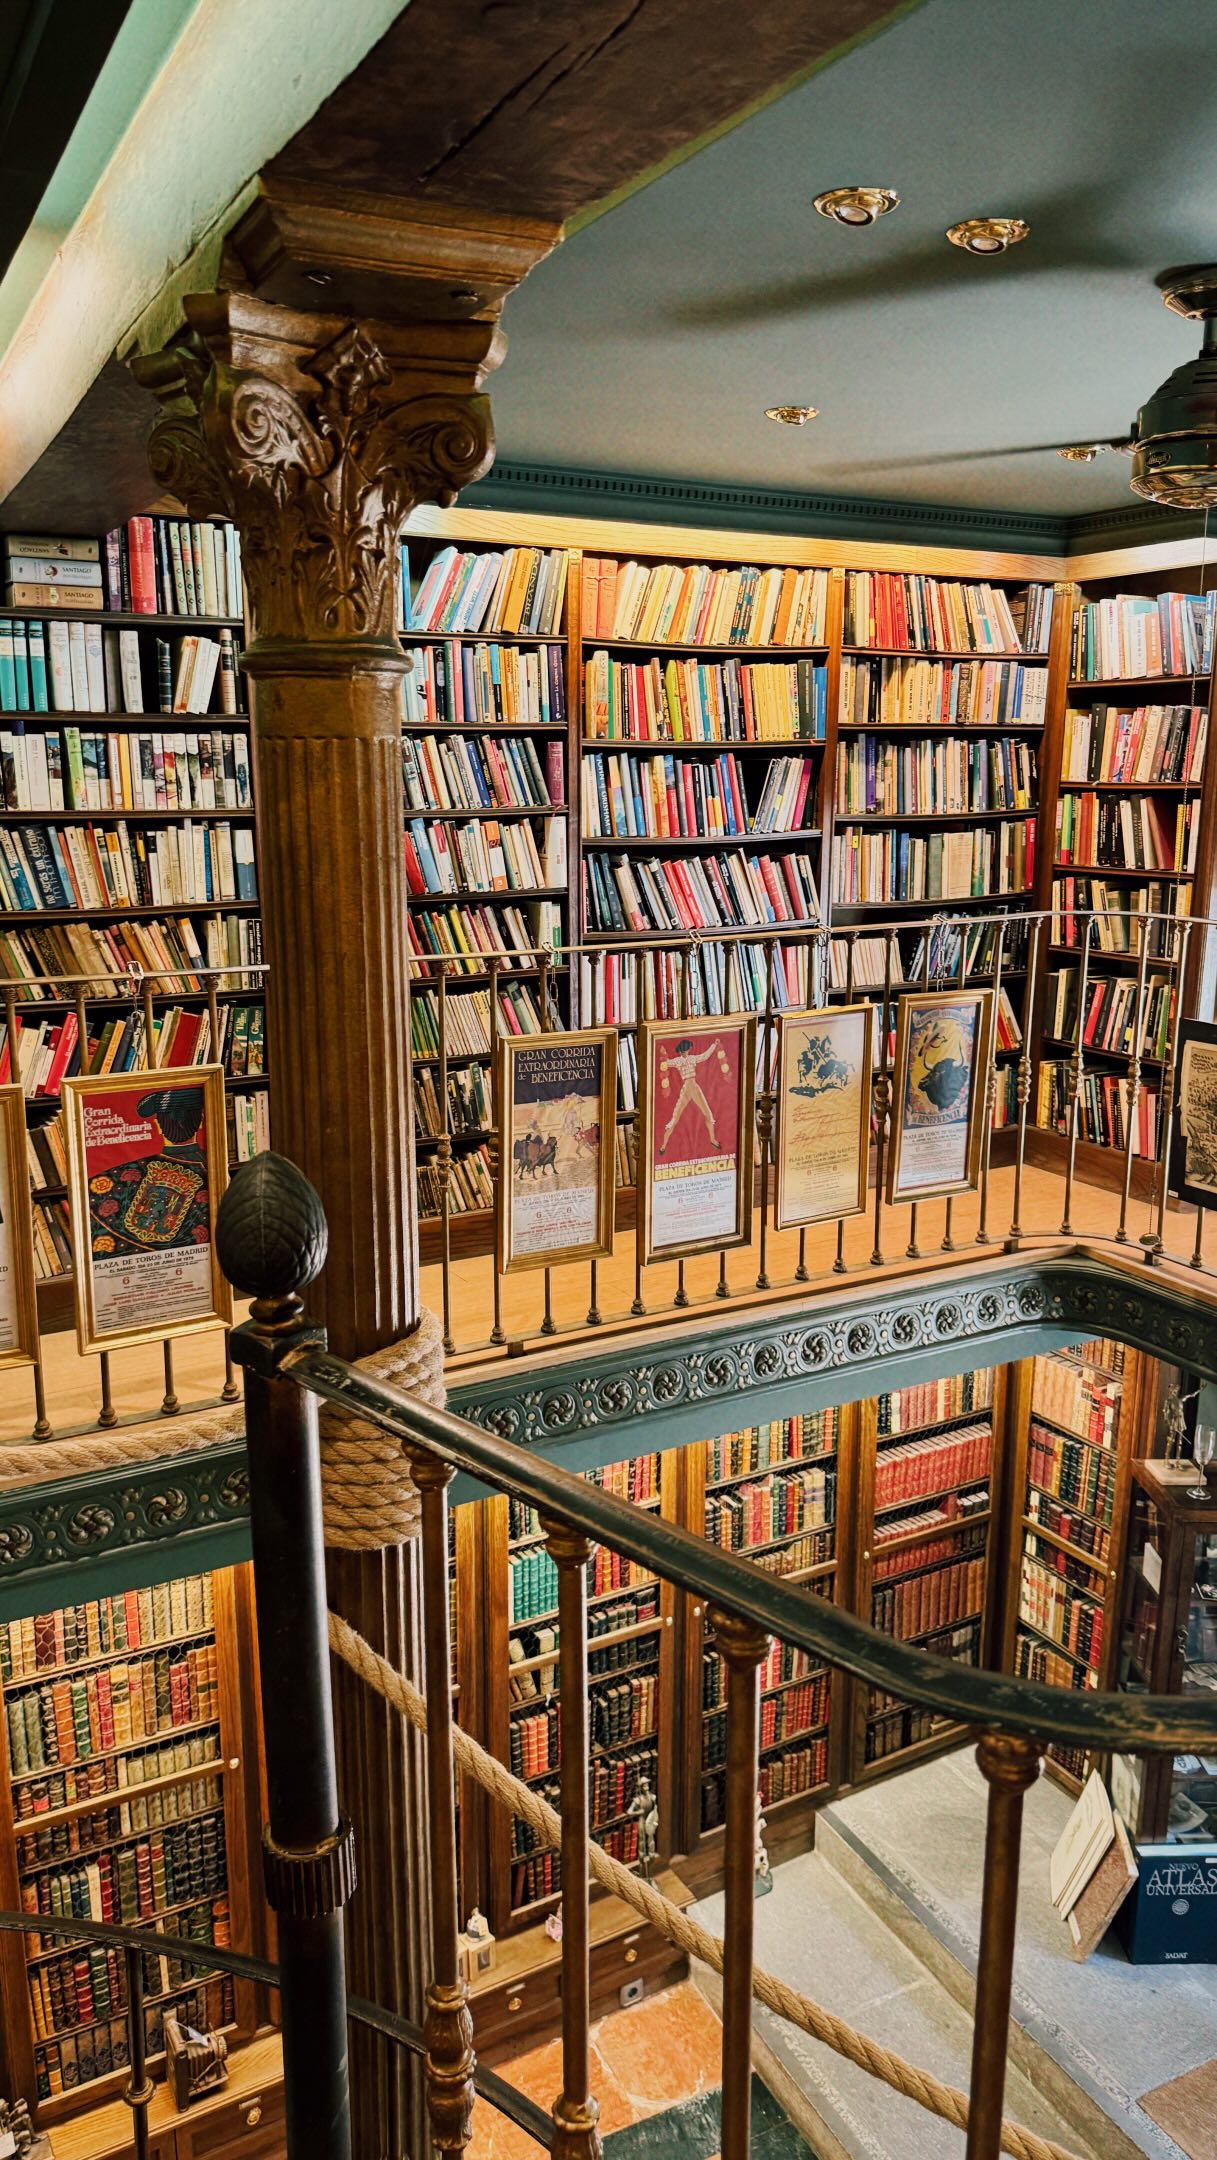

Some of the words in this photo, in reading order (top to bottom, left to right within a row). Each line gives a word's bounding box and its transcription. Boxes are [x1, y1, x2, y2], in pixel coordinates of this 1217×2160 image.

[522, 552, 542, 615] BRANDO
[596, 759, 606, 781] JOHN
[601, 791, 611, 827] GRISHAM
[518, 1050, 547, 1061] GRAN
[551, 1046, 595, 1059] CORRIDA
[518, 1057, 595, 1073] EXTRAORDINARIA
[531, 1068, 595, 1084] BENEFICENCIA
[83, 1107, 112, 1117] Gran
[84, 1113, 125, 1127] Corrida
[85, 1120, 153, 1138] Extraordinaria
[86, 1137, 97, 1147] de
[96, 1130, 153, 1146] Beneficencia
[655, 1159, 736, 1180] BENEFICENCIA
[94, 1261, 119, 1270] PLAZA
[122, 1258, 133, 1266] DE
[135, 1255, 161, 1264] TOROS
[177, 1247, 208, 1257] MADRID
[122, 1277, 130, 1285] 6
[175, 1268, 183, 1276] 6
[1169, 1863, 1199, 1871] NUEVO
[1147, 1868, 1217, 1887] ATLAS
[1146, 1884, 1217, 1896] UNIVERSAL
